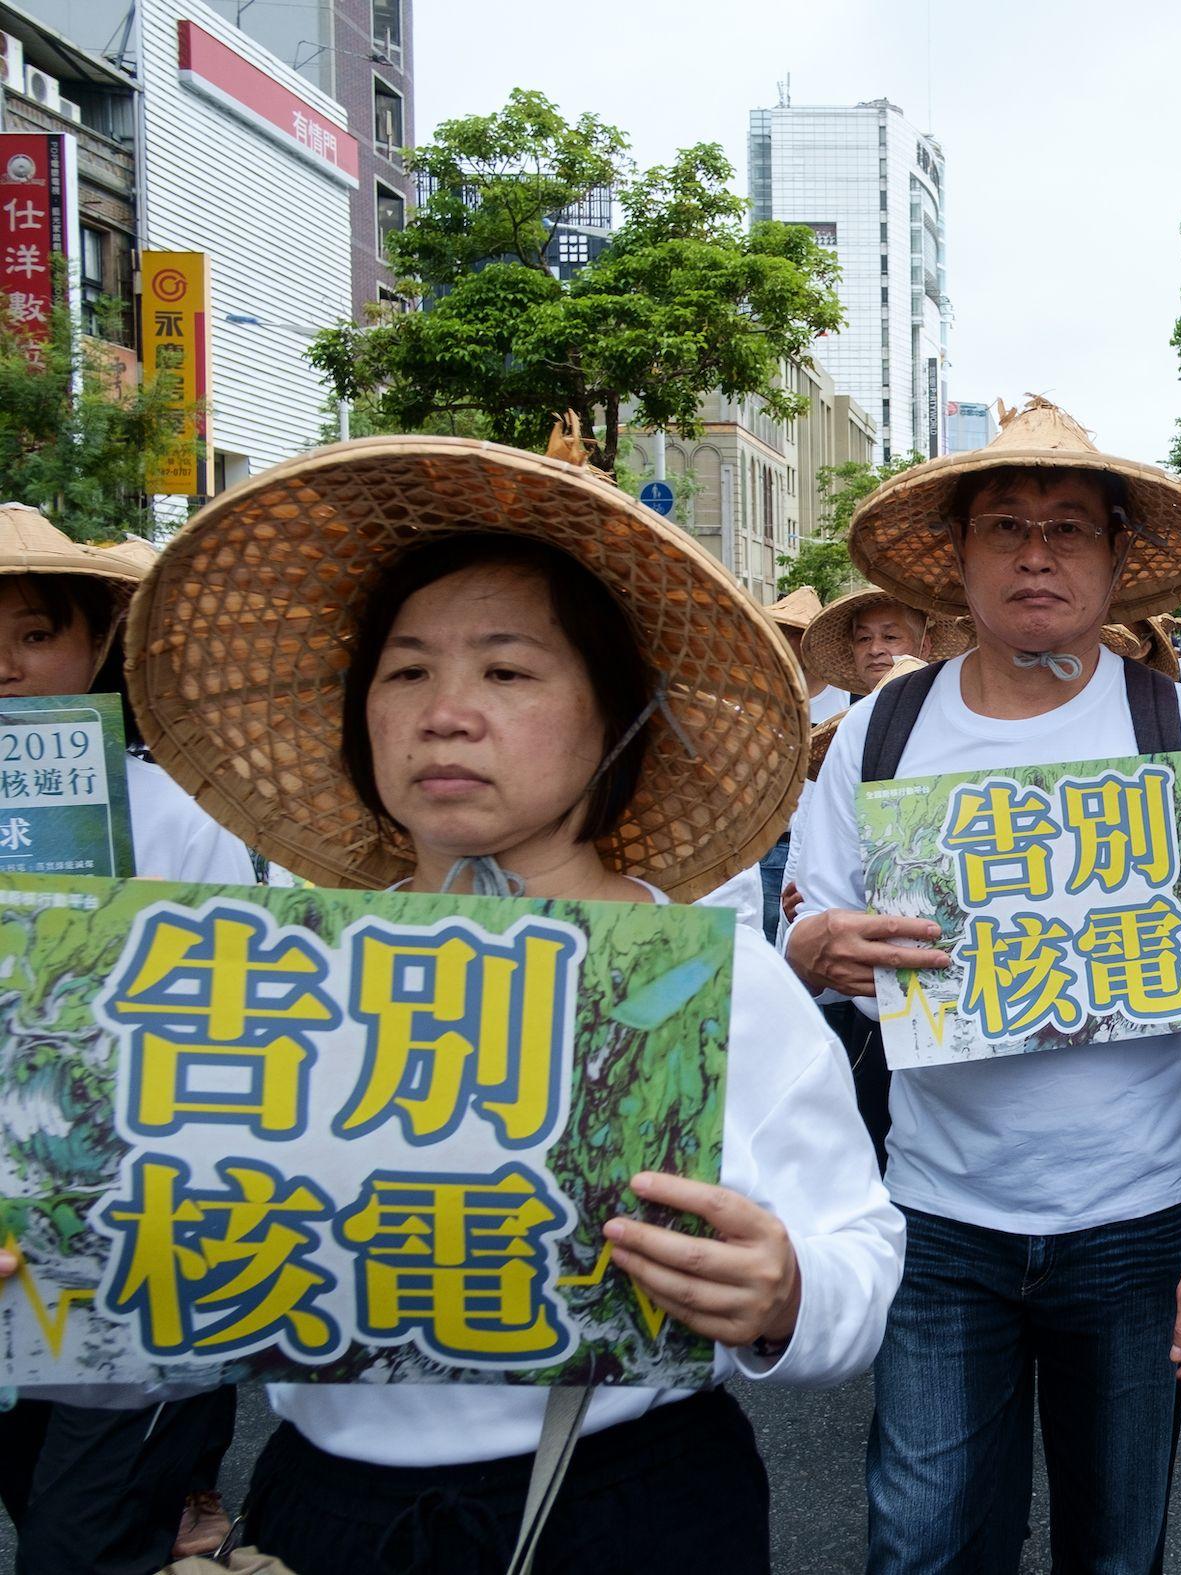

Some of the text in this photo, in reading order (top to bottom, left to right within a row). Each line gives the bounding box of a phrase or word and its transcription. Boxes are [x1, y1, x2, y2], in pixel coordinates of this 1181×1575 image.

[292, 110, 338, 167] 有情門
[1, 730, 90, 763] 2019
[1, 817, 33, 851] 求
[942, 767, 1177, 909] 告別
[106, 908, 577, 1150] 告別
[101, 1151, 570, 1365] 核電
